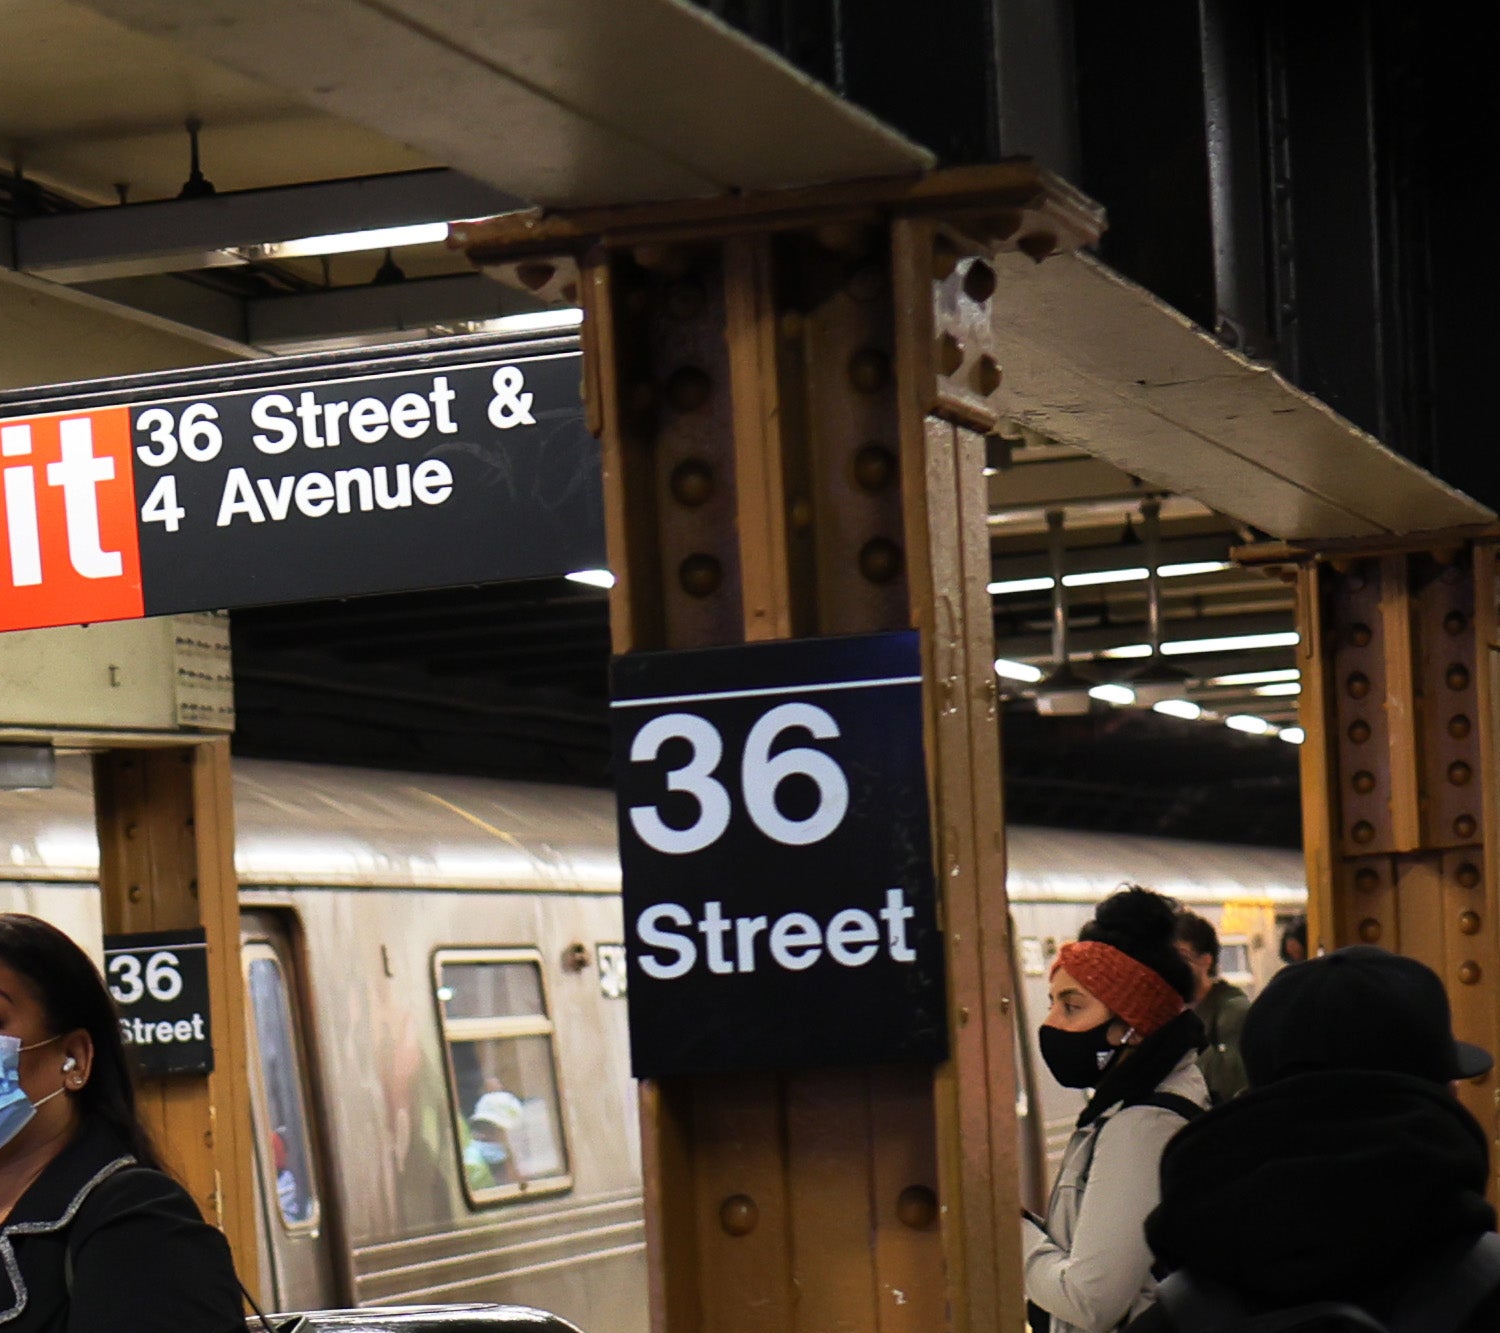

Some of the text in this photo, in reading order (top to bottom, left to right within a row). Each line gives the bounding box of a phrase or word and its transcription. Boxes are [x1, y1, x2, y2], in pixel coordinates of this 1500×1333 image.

[136, 366, 537, 467] 36 Street &
[141, 459, 453, 532] 4 Avenue
[629, 702, 849, 854] 36
[637, 888, 916, 979] Street
[109, 951, 183, 1003] 36
[119, 1013, 205, 1044] Street
